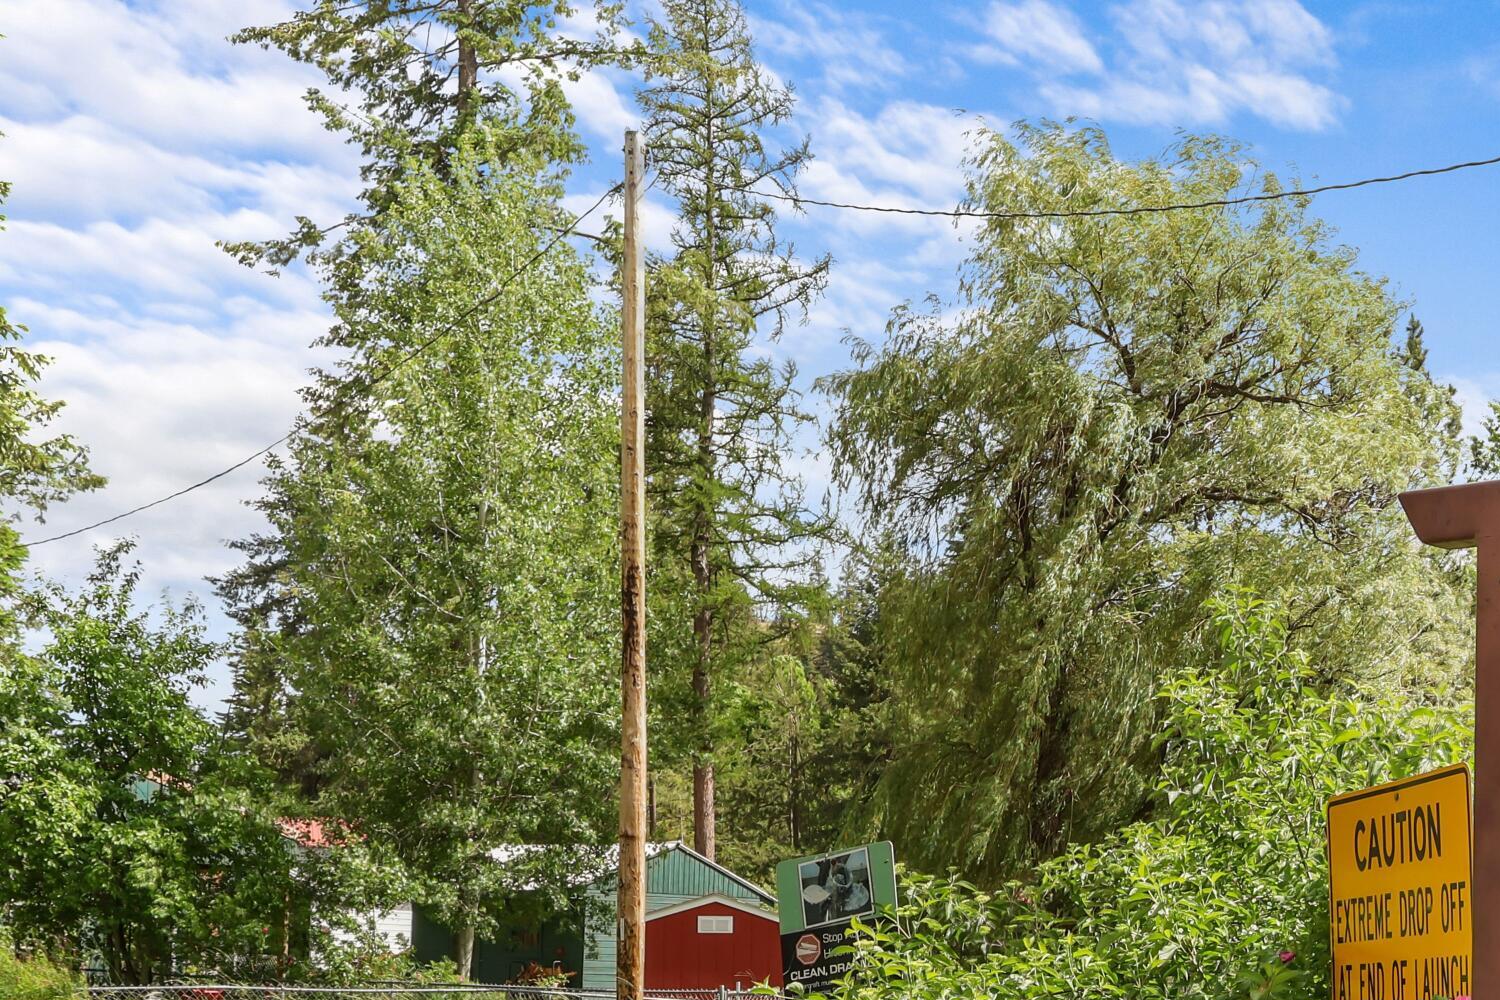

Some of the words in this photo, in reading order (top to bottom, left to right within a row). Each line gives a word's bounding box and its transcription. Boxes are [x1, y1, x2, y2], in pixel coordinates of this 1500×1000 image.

[1354, 802, 1442, 872] CAUTION
[1336, 892, 1392, 944] EXTREME
[1400, 886, 1432, 937] DROP
[1441, 881, 1466, 934] OFF
[823, 933, 842, 944] Stop
[791, 966, 828, 981] CLEAN,
